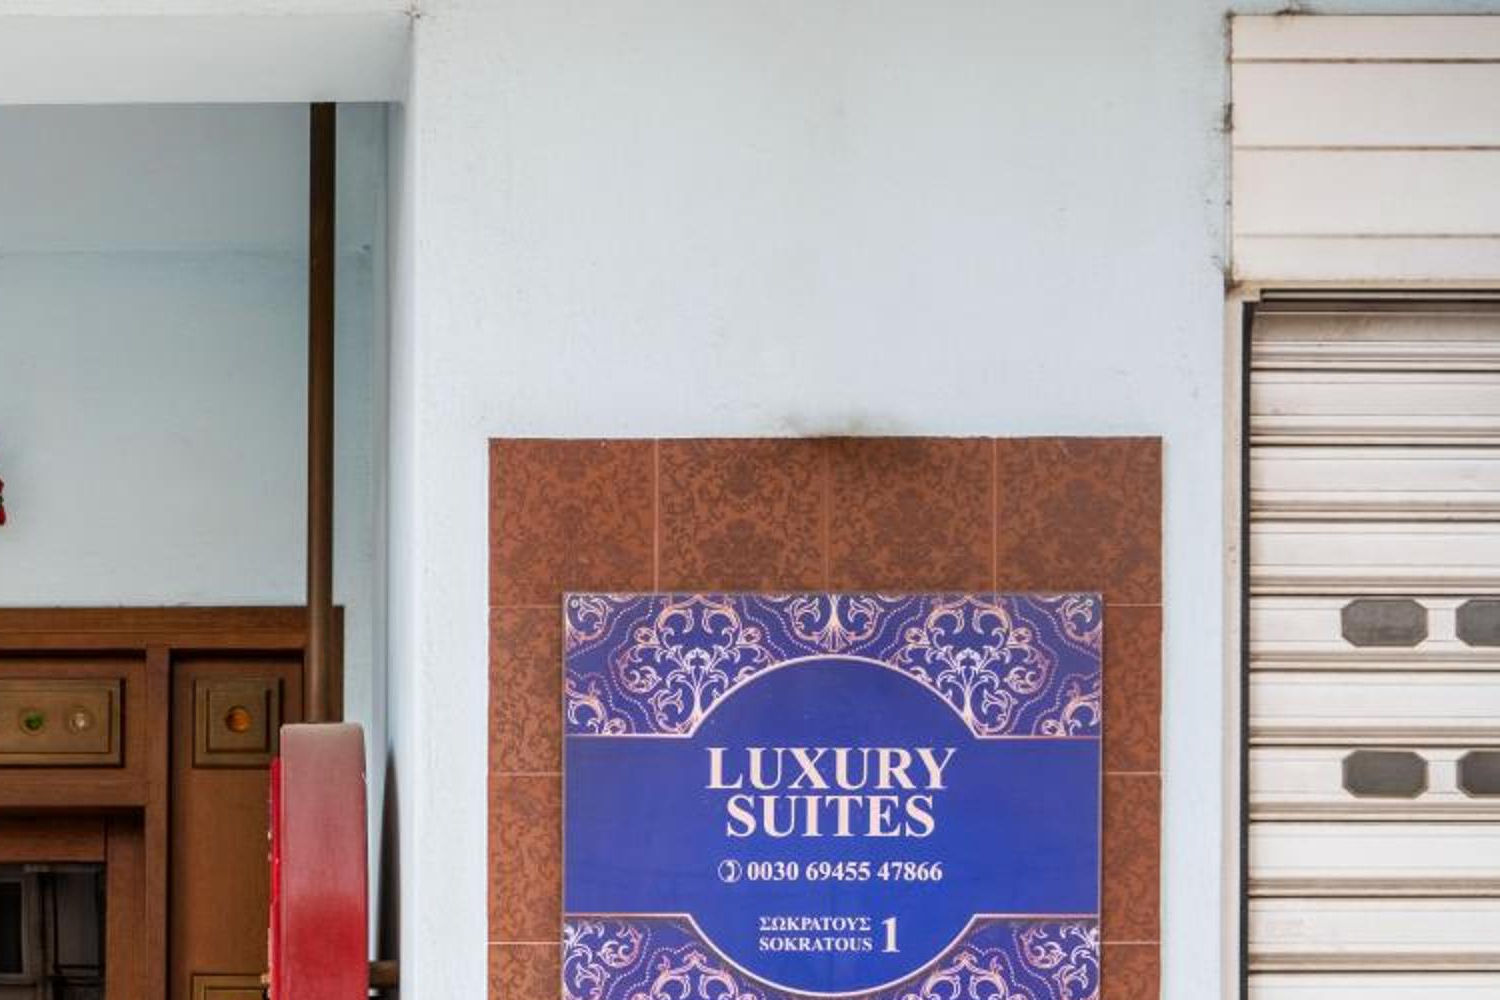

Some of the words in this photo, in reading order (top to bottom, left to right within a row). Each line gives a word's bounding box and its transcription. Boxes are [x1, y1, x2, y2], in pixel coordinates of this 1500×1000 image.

[705, 746, 956, 790] LUXURY
[726, 795, 936, 838] SUITES
[747, 861, 799, 882] 0030
[805, 861, 871, 882] 69455
[877, 861, 943, 882] 47866
[758, 916, 871, 931] ΣΩΚΡΑΤΟΥΣ
[881, 917, 900, 953] 1
[758, 937, 873, 952] SOKRATOUS
